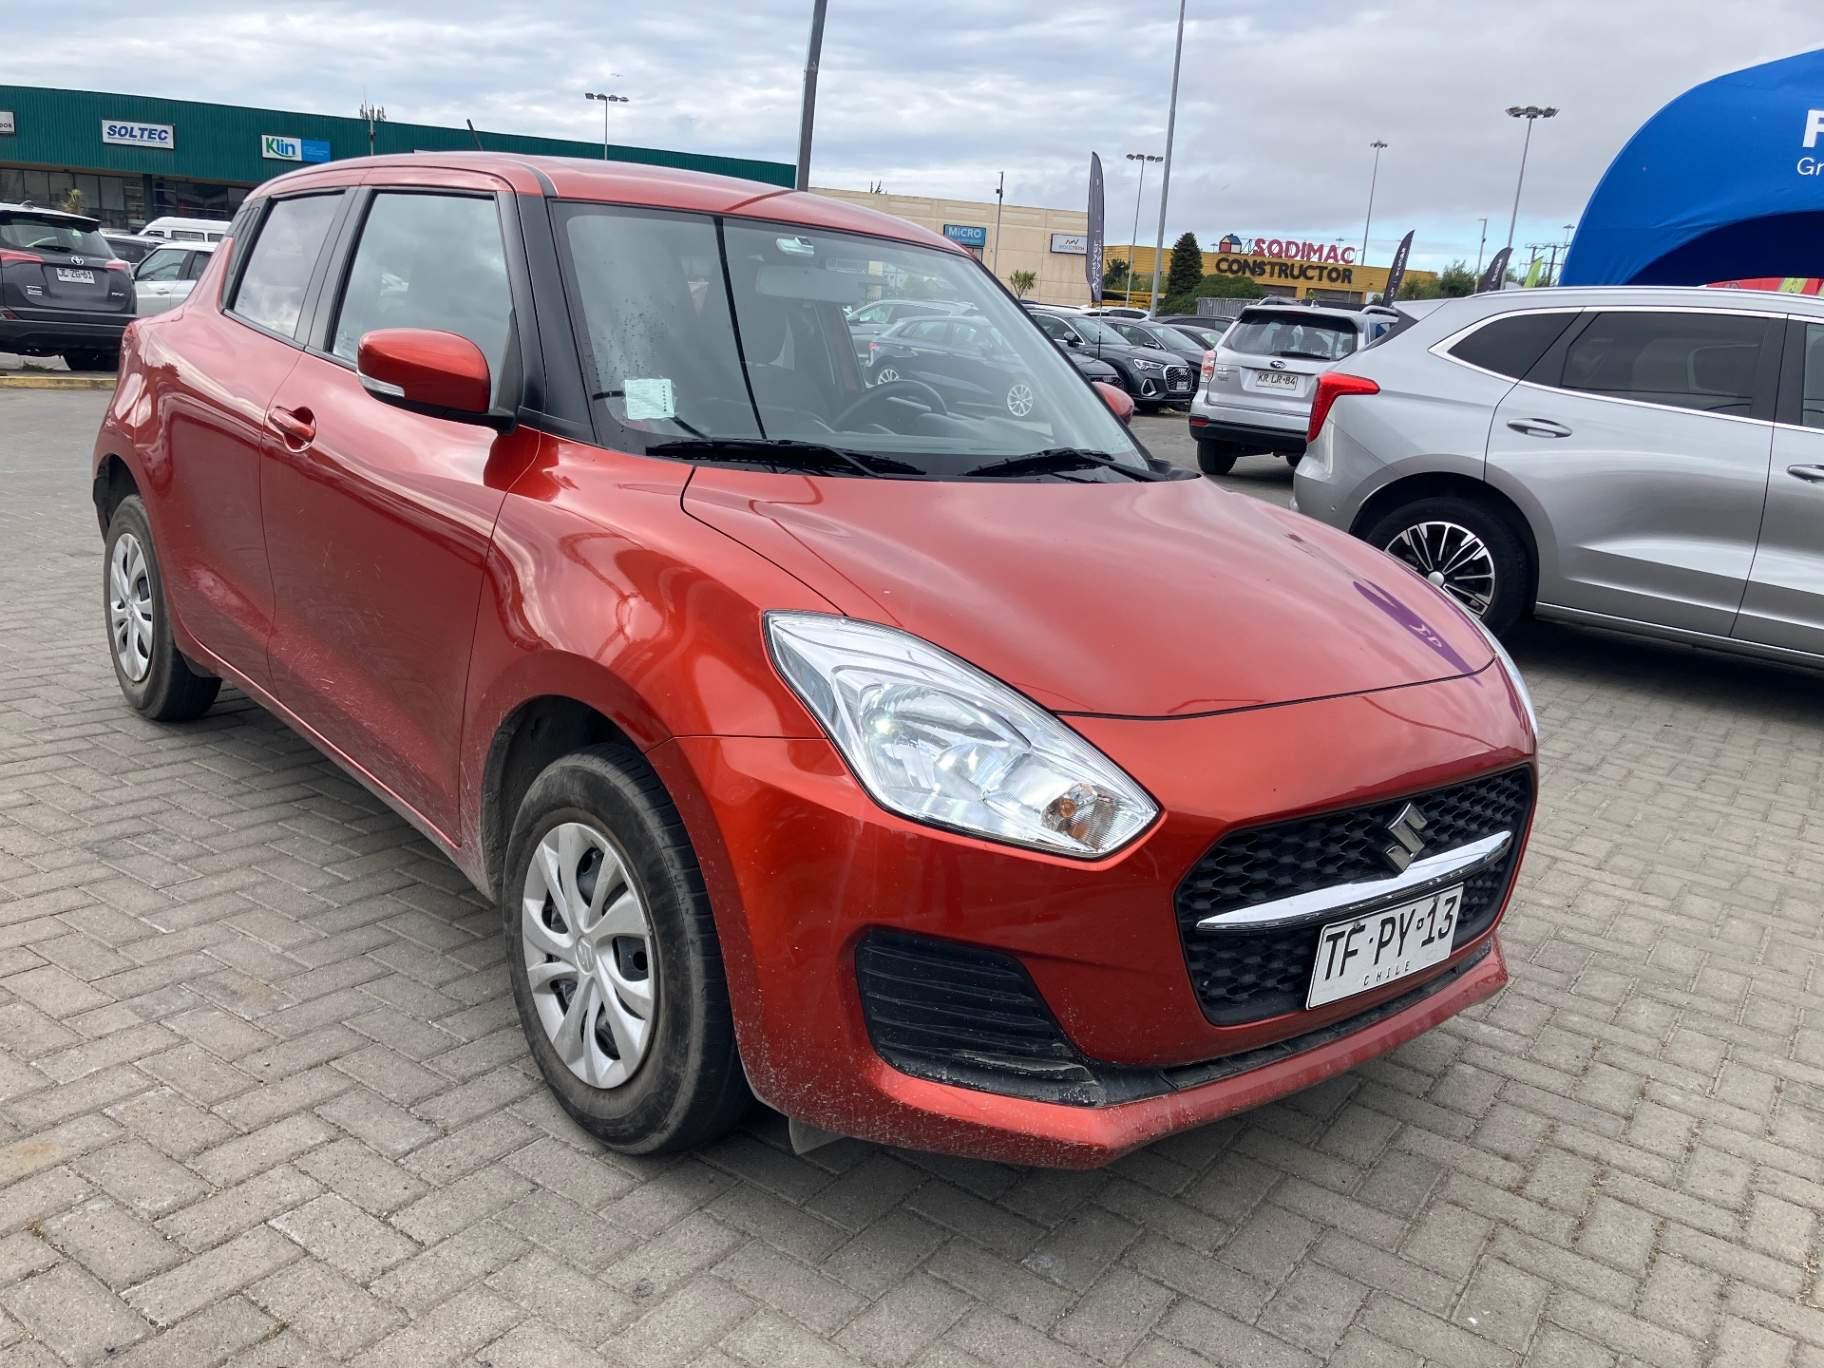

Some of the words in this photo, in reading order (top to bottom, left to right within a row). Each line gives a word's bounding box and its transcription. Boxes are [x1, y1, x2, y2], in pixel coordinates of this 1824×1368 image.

[107, 124, 169, 141] SOLTEC
[266, 137, 297, 157] Klin
[1251, 237, 1356, 264] SODIMAC
[1215, 256, 1353, 284] CONSTRUCTOR
[1363, 960, 1411, 986] CHILE
